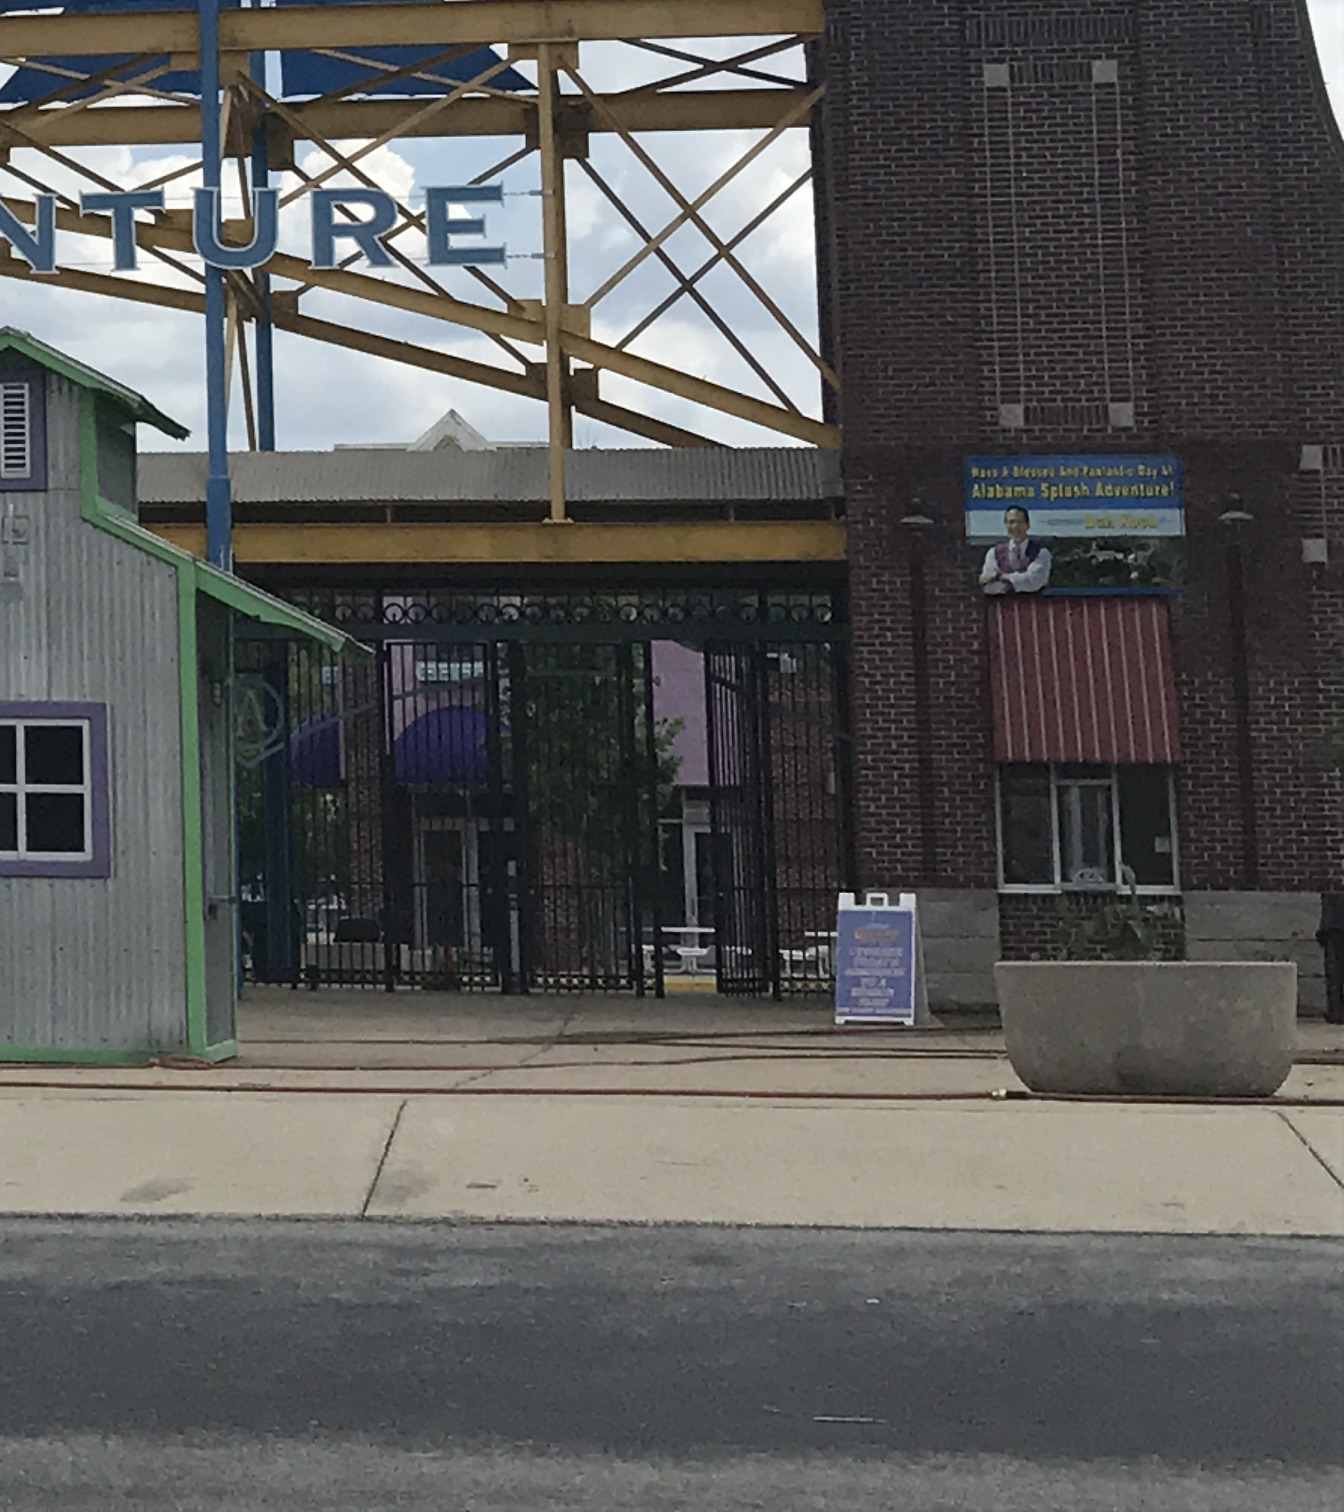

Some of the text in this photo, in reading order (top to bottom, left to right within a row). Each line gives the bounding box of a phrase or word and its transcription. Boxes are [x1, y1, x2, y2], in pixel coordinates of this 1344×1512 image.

[1137, 464, 1157, 480] Day
[972, 481, 1174, 501] Alabama Splash Adventure!
